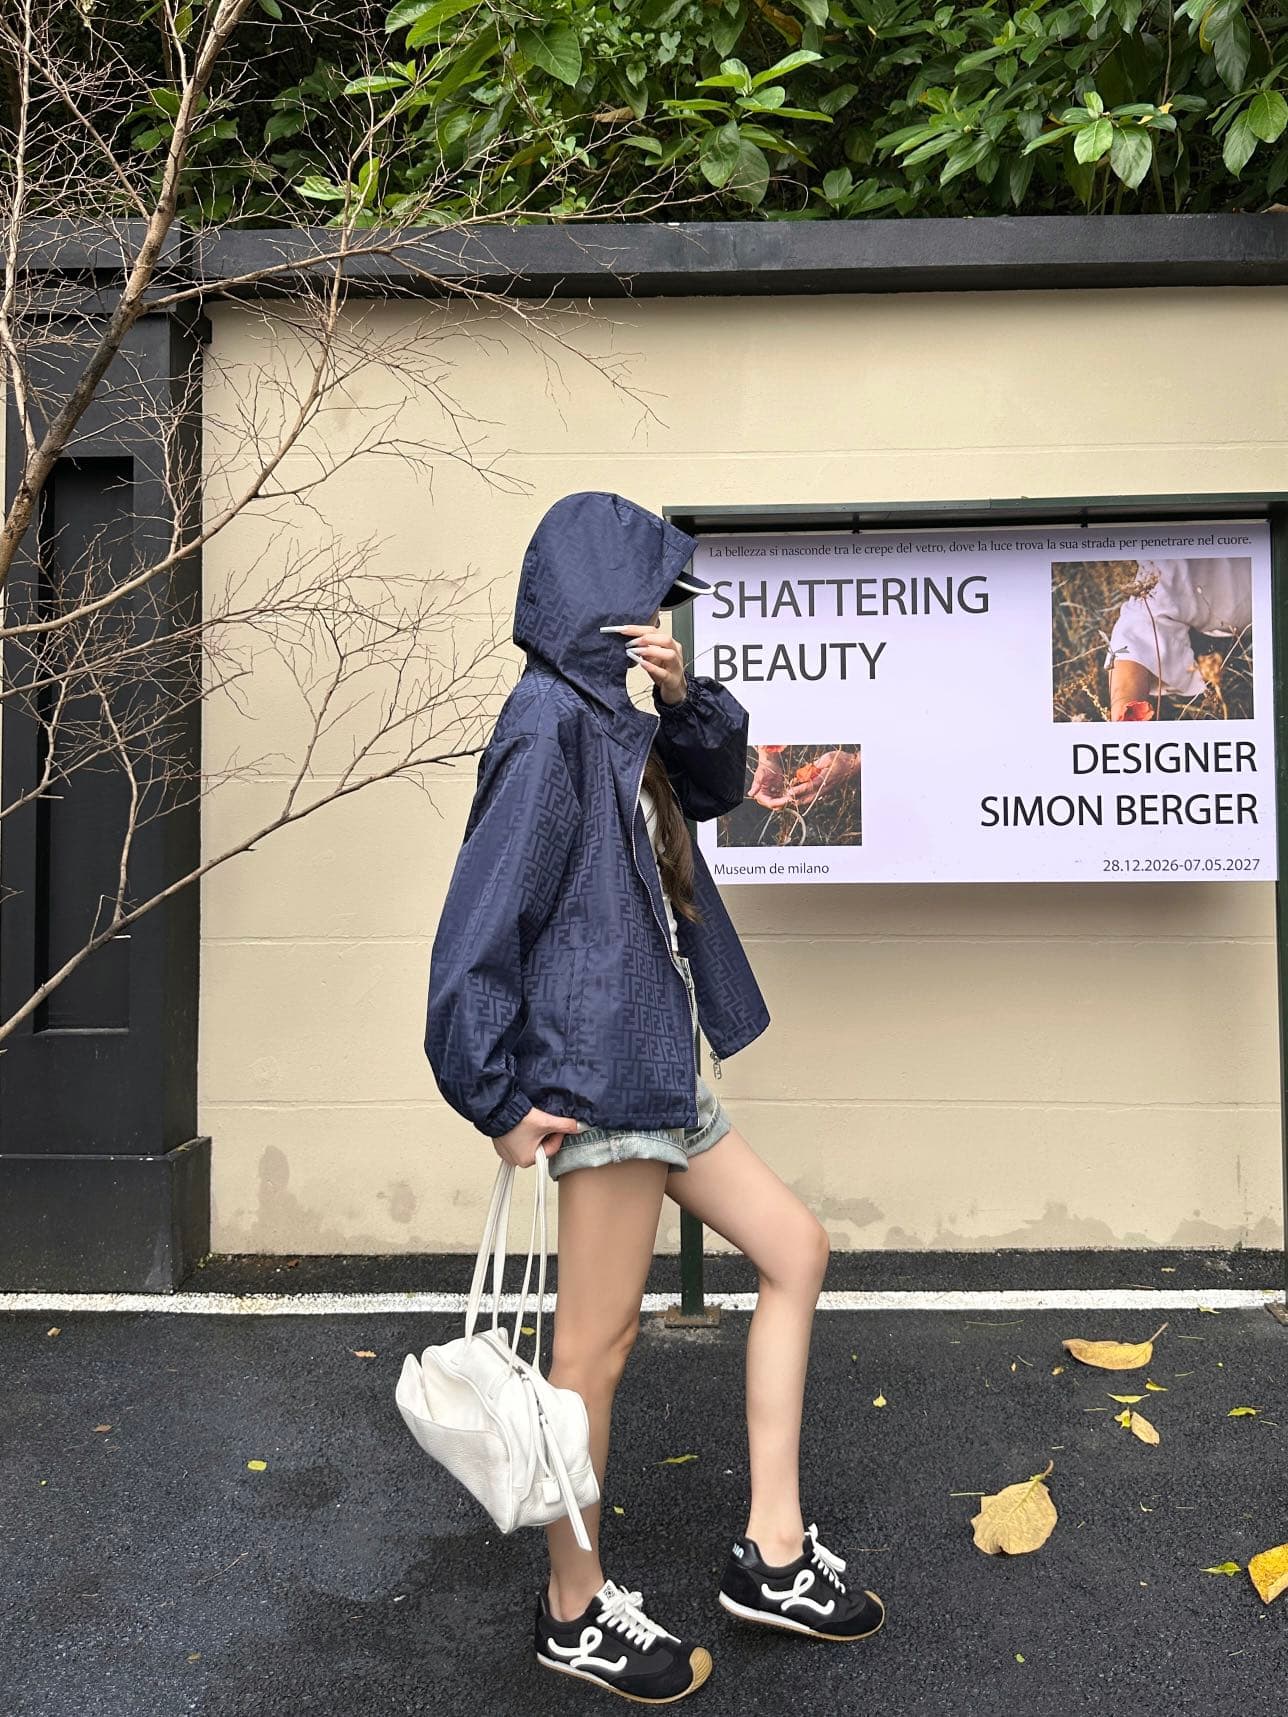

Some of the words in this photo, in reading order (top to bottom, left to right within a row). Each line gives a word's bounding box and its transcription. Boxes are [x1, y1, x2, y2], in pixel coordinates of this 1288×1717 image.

[709, 546, 722, 557] La
[725, 545, 767, 557] bellezza
[769, 545, 778, 556] si
[781, 544, 832, 556] nasconde
[834, 546, 850, 555] tra
[852, 544, 862, 555] le
[864, 545, 894, 557] crepe
[896, 542, 912, 554] del
[915, 544, 946, 554] vetro,
[949, 541, 975, 553] dove
[978, 540, 988, 552] la
[990, 540, 1013, 552] luce
[1015, 542, 1044, 551] trova
[1047, 538, 1057, 550] la
[1059, 540, 1078, 550] sua
[1081, 537, 1116, 549] strada
[1119, 539, 1137, 550] per
[1141, 537, 1195, 550] penetrare
[1197, 535, 1214, 546] nel
[1217, 536, 1252, 546] cuore.
[711, 575, 990, 619] SHATTERING
[713, 641, 887, 683] BEAUTY
[1072, 741, 1258, 775] DESIGNER
[980, 794, 1103, 827] SIMON
[1116, 793, 1259, 826] BERGER
[713, 863, 767, 875] Museum
[769, 862, 785, 875] de
[787, 861, 830, 876] milano
[1102, 857, 1261, 872] 28.12.2026-07.05.2027
